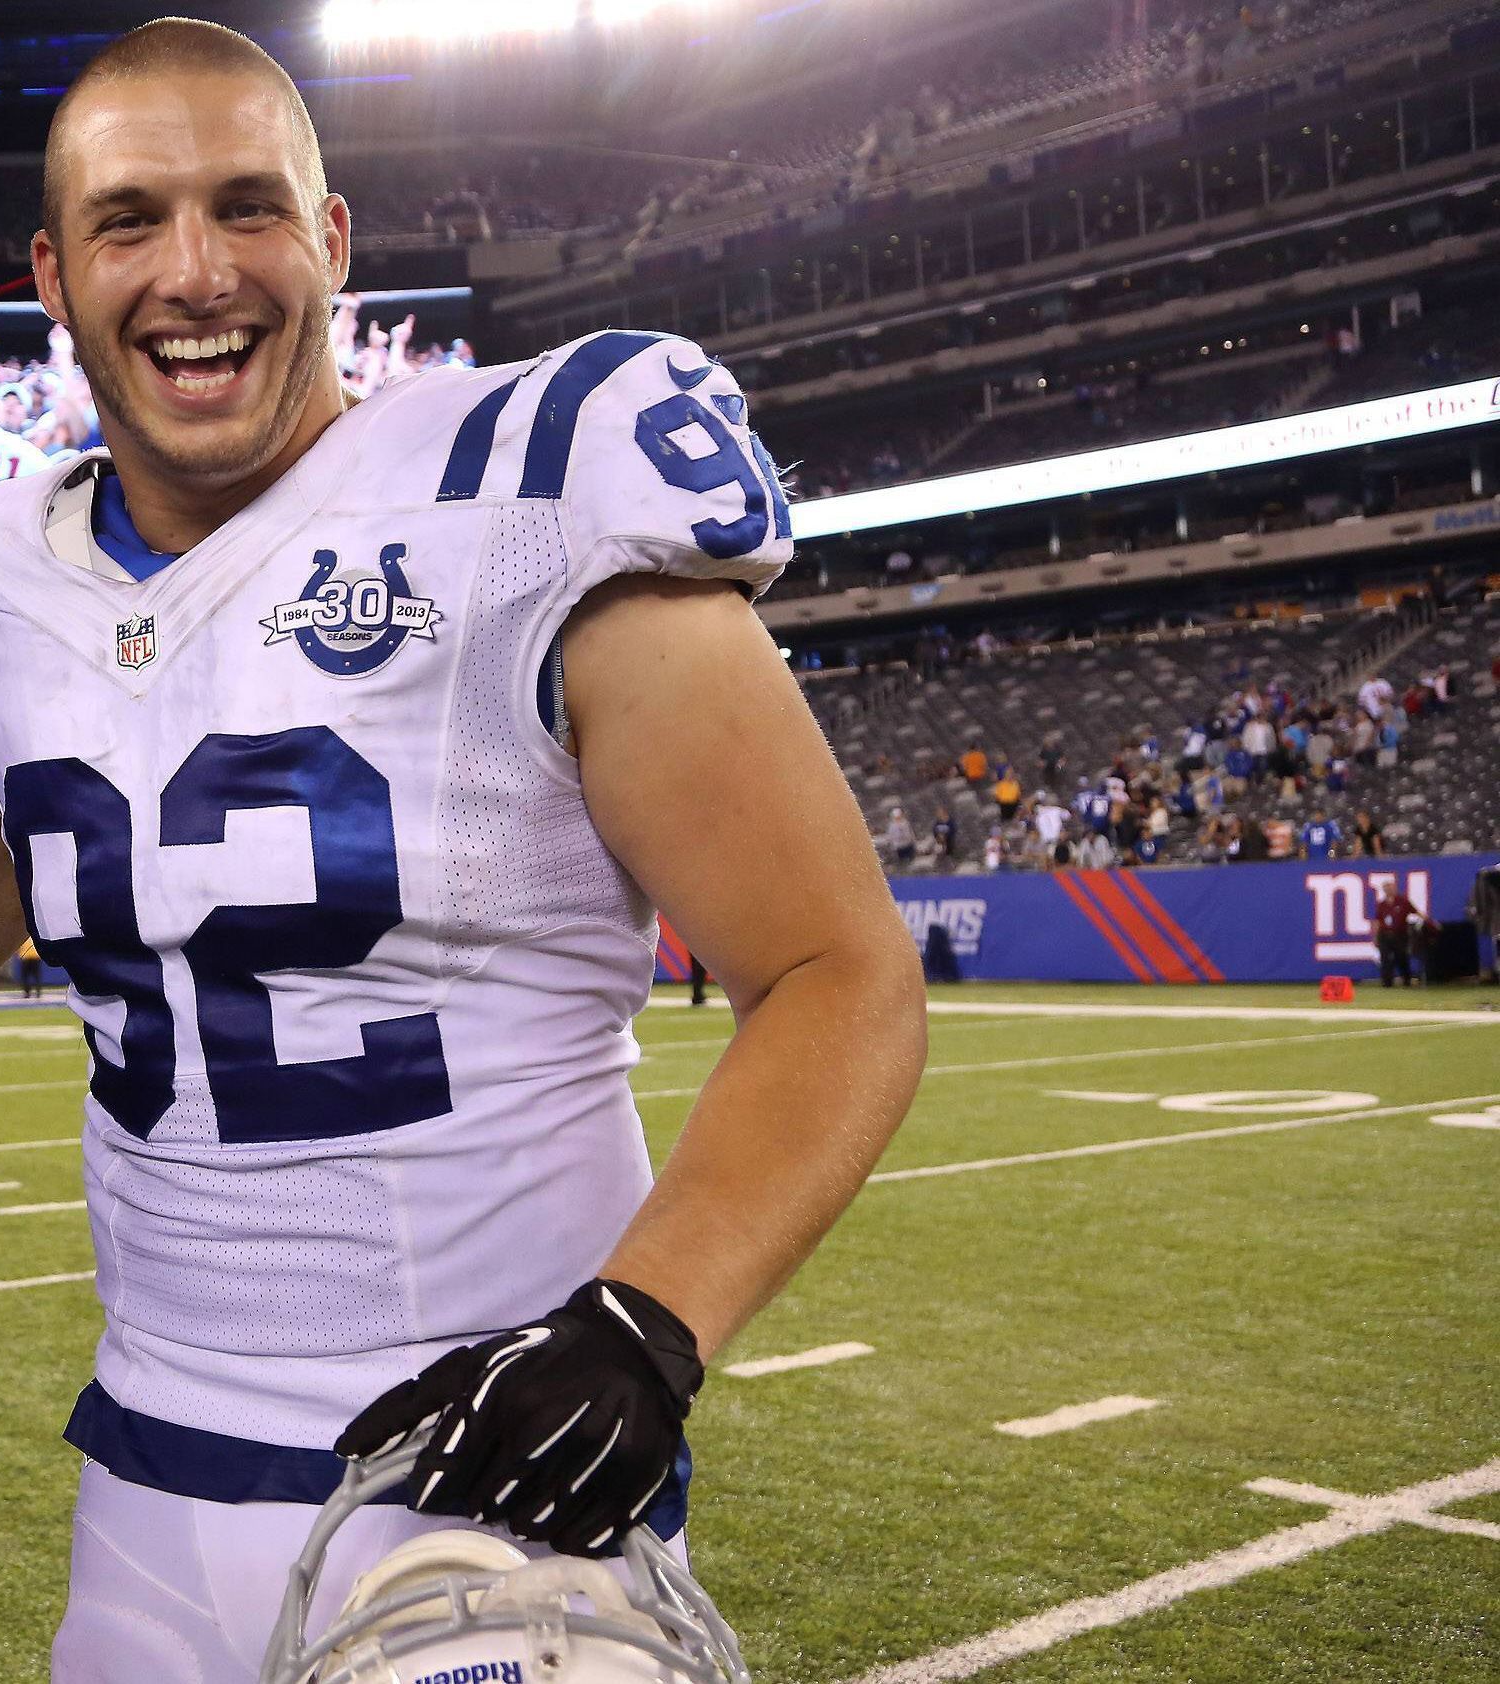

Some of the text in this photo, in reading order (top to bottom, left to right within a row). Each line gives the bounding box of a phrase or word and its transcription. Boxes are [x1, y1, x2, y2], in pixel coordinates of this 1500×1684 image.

[283, 578, 426, 632] 1984 30 2013
[121, 636, 153, 663] NFL
[327, 632, 373, 641] SEASONS
[3, 725, 453, 1143] 92
